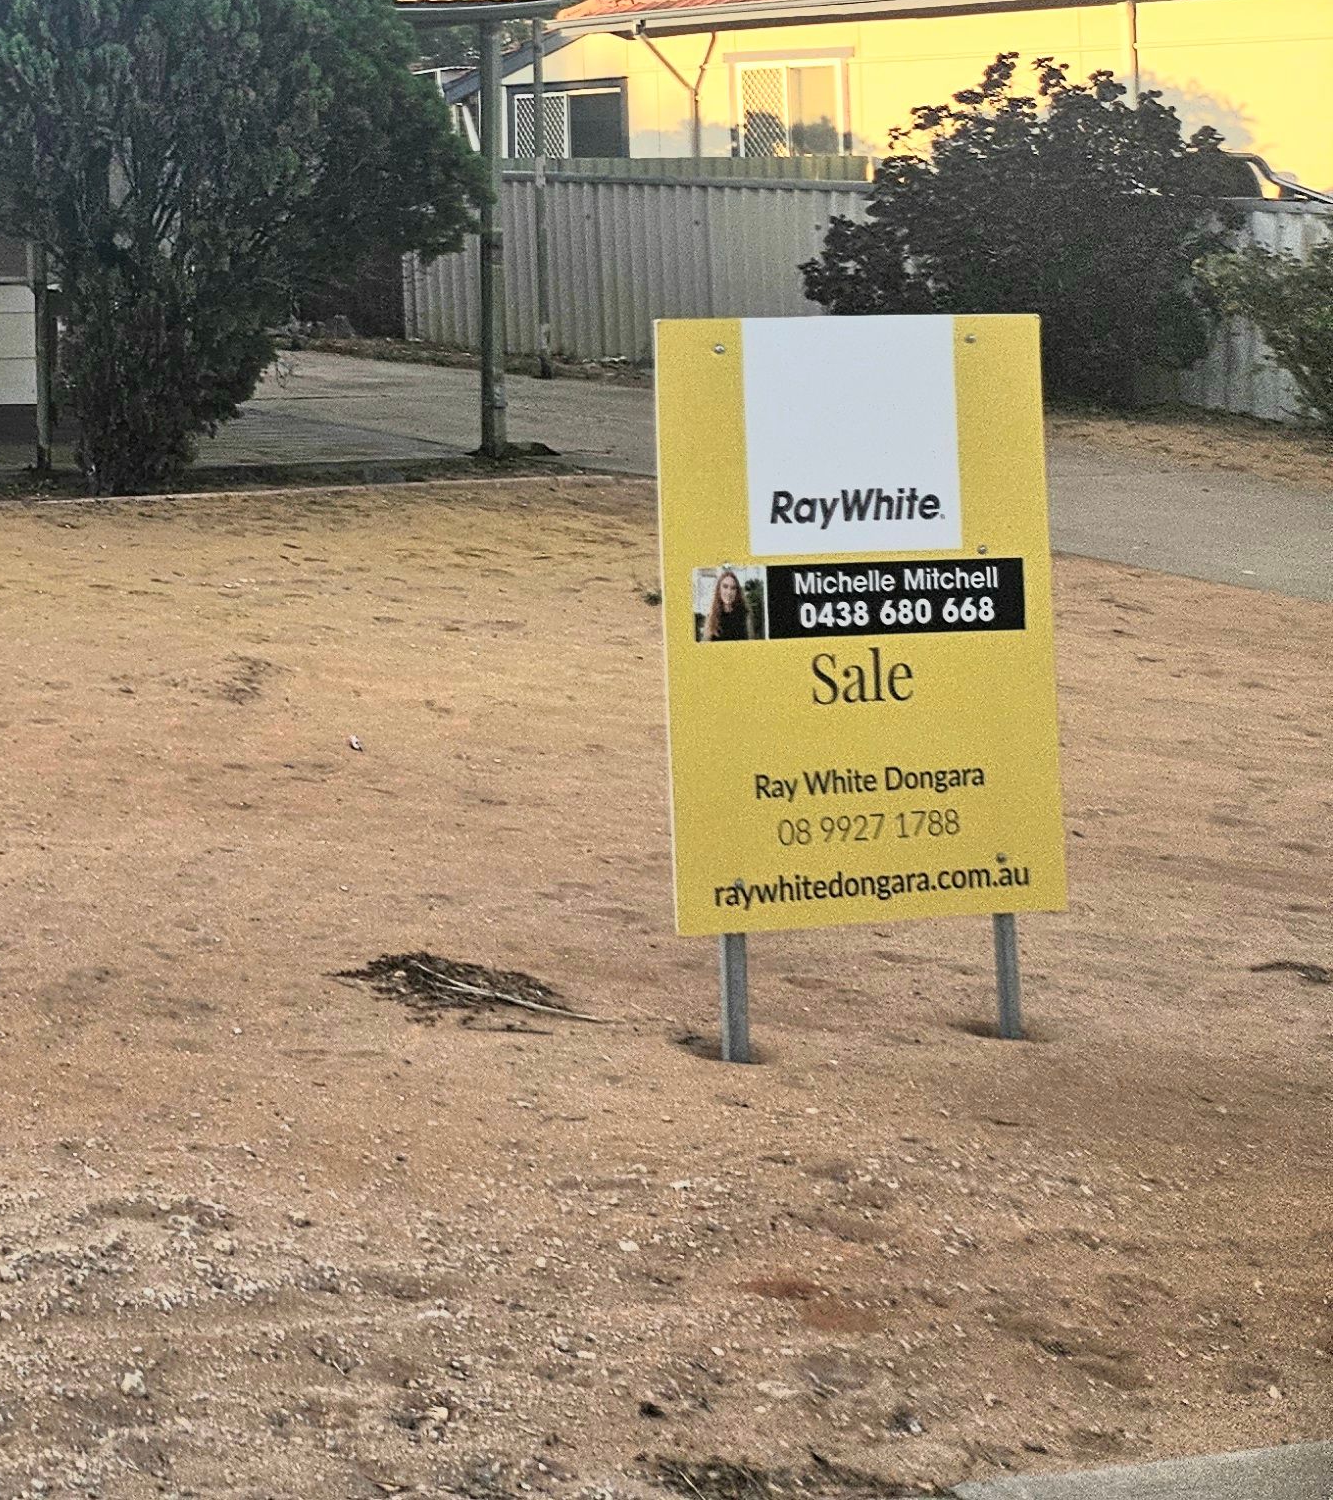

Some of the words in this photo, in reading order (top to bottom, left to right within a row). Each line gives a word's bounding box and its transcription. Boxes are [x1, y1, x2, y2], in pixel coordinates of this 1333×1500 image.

[794, 569, 896, 595] Michelle
[904, 566, 999, 590] Mitchell
[800, 601, 869, 628] 0438
[880, 598, 932, 625] 680
[942, 596, 995, 623] 668
[812, 647, 914, 705] Sale
[754, 773, 798, 802] Ray
[804, 769, 877, 795] White
[885, 766, 985, 793] Dongara
[778, 818, 812, 846] 08
[820, 813, 885, 843] 9927
[895, 808, 960, 838] 1788
[714, 865, 1030, 911] raywhitedongara.com.au
